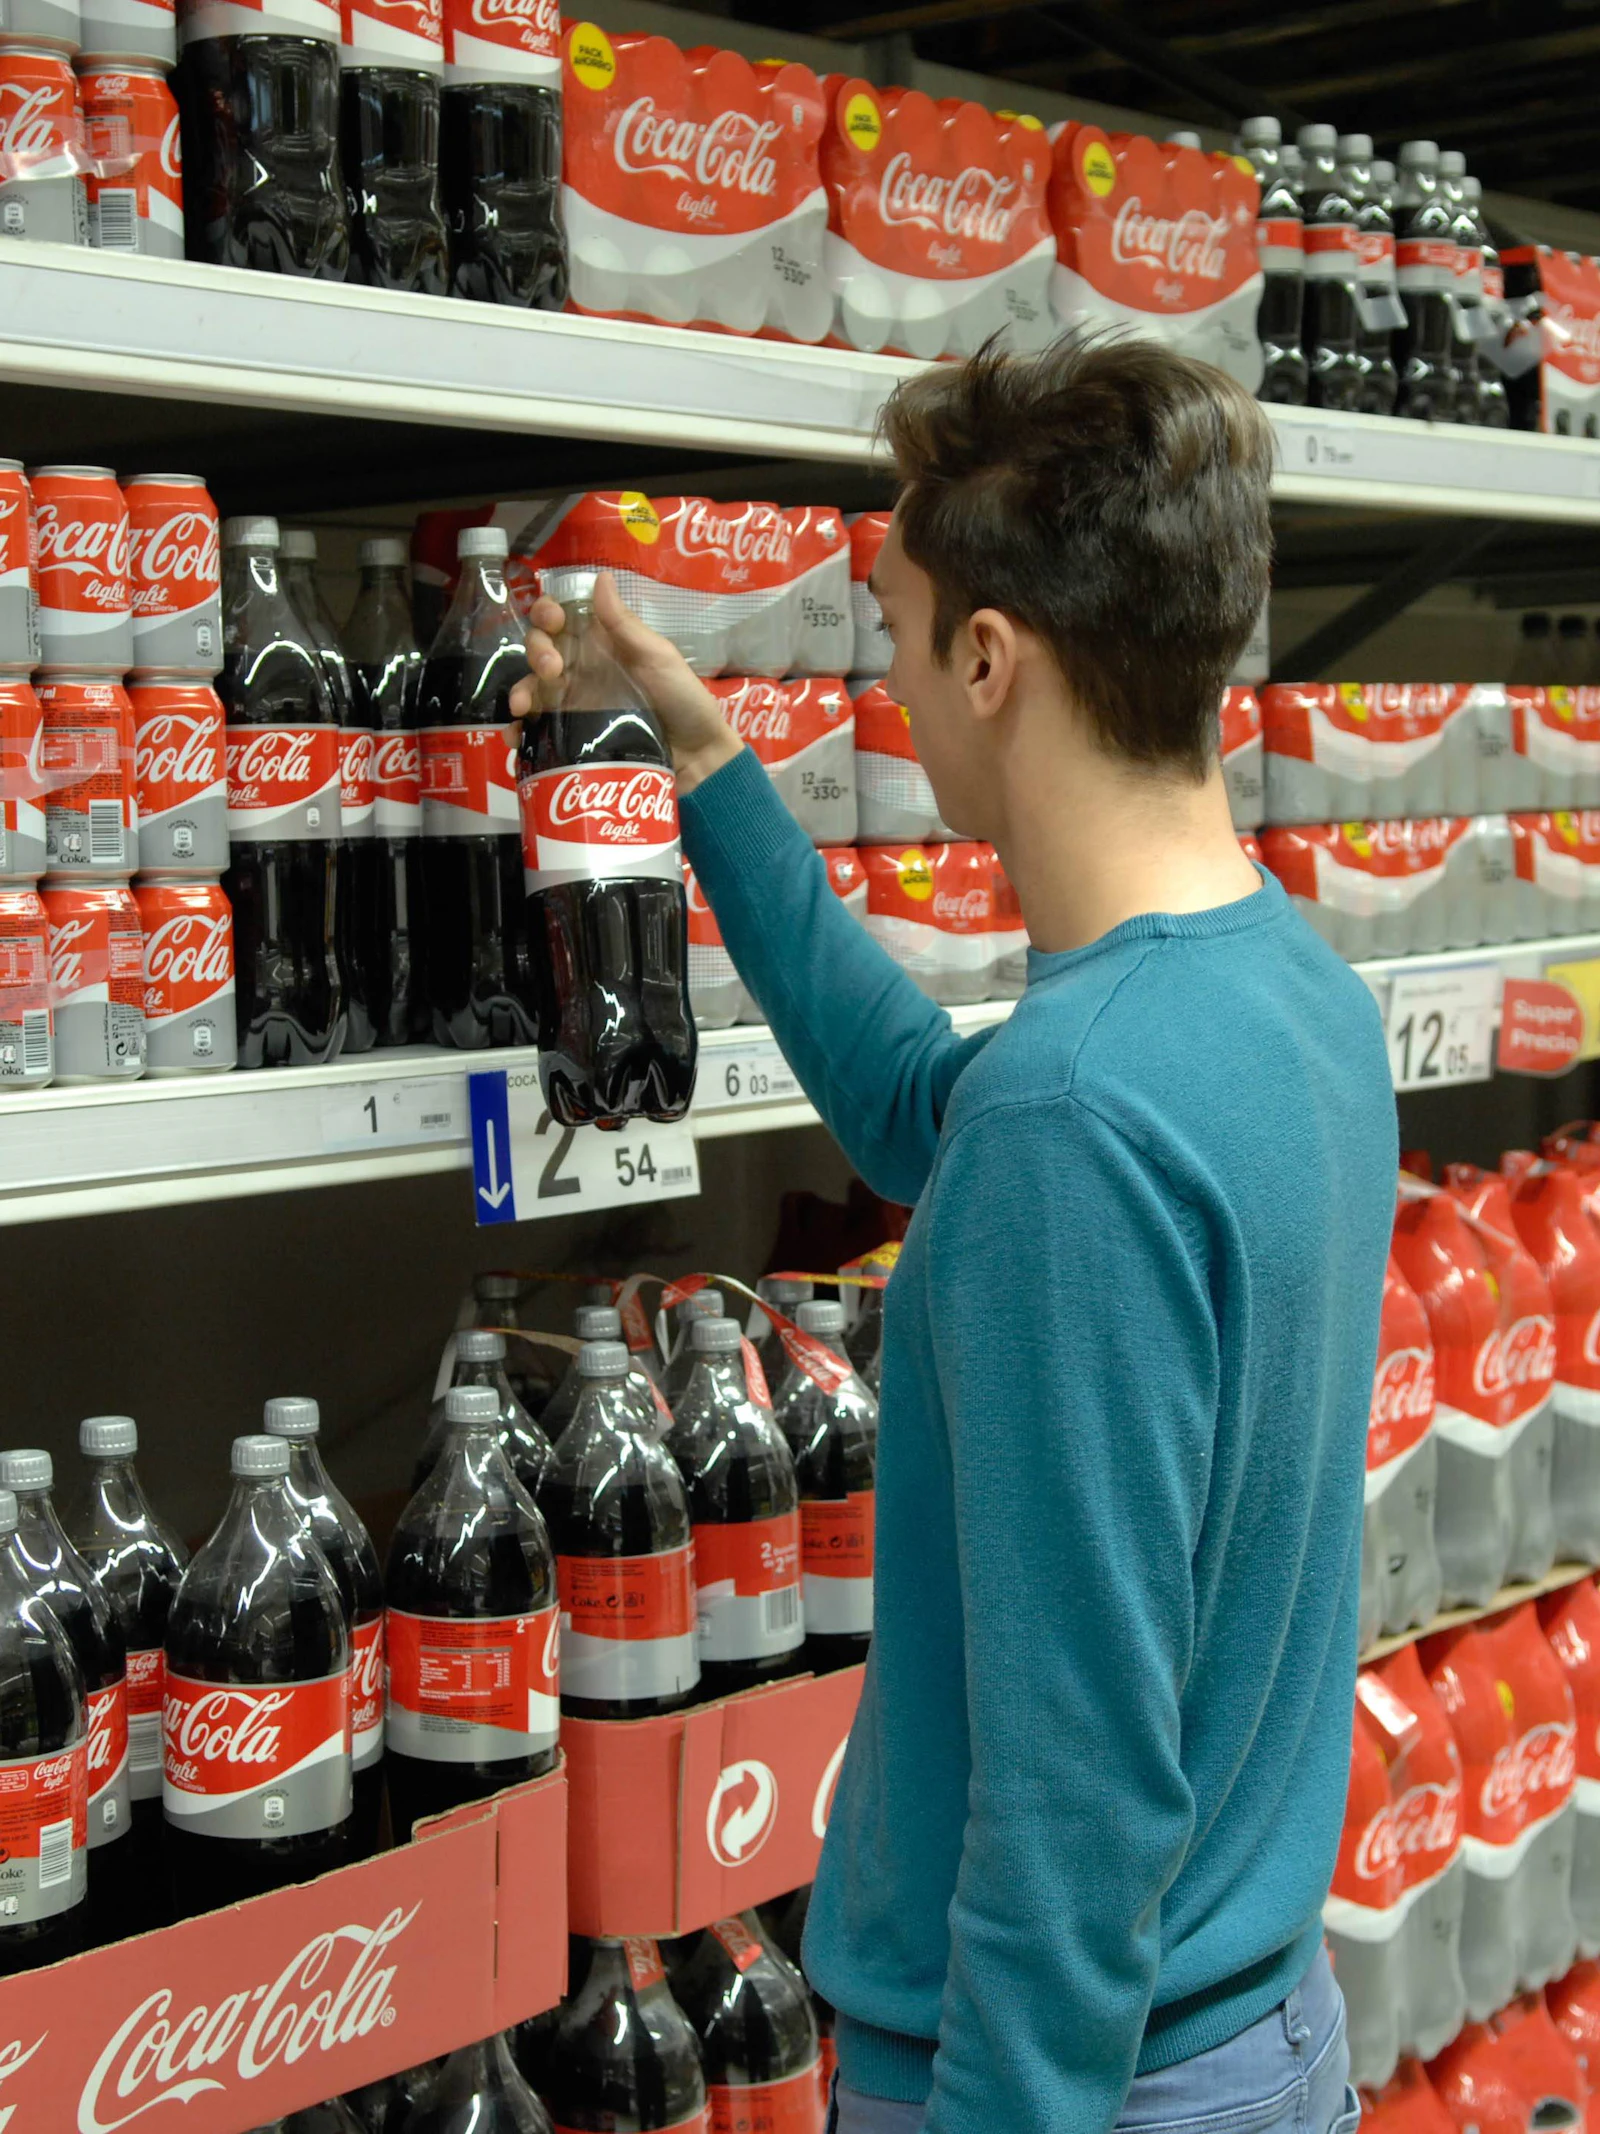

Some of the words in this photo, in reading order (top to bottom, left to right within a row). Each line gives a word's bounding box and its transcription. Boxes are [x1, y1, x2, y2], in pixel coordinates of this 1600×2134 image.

[614, 96, 784, 196] Coca-Cola
[675, 191, 718, 222] light
[878, 152, 1016, 243] Coca-Cola
[1112, 195, 1232, 281] Coca-Cola
[674, 499, 791, 564] Coca-Cola
[82, 578, 126, 606] light
[801, 598, 814, 611] 12
[812, 612, 839, 628] 330
[801, 772, 815, 785] 12
[549, 770, 675, 826] Coca-Cola
[812, 786, 840, 800] 330
[598, 820, 640, 842] light
[60, 853, 87, 864] Coke
[1511, 999, 1577, 1025] Super
[1396, 1009, 1446, 1082] 12
[1510, 1028, 1579, 1053] Precio
[507, 1074, 538, 1089] COCA
[725, 1062, 741, 1098] 6
[749, 1074, 769, 1096] 03
[363, 1095, 378, 1134] 1
[534, 1108, 581, 1199] 2
[615, 1143, 658, 1187] 54
[760, 1542, 773, 1559] 2
[516, 1618, 525, 1634] 2
[34, 1753, 74, 1780] Coca-Cola
[77, 1899, 424, 2134] Coca-Cola
